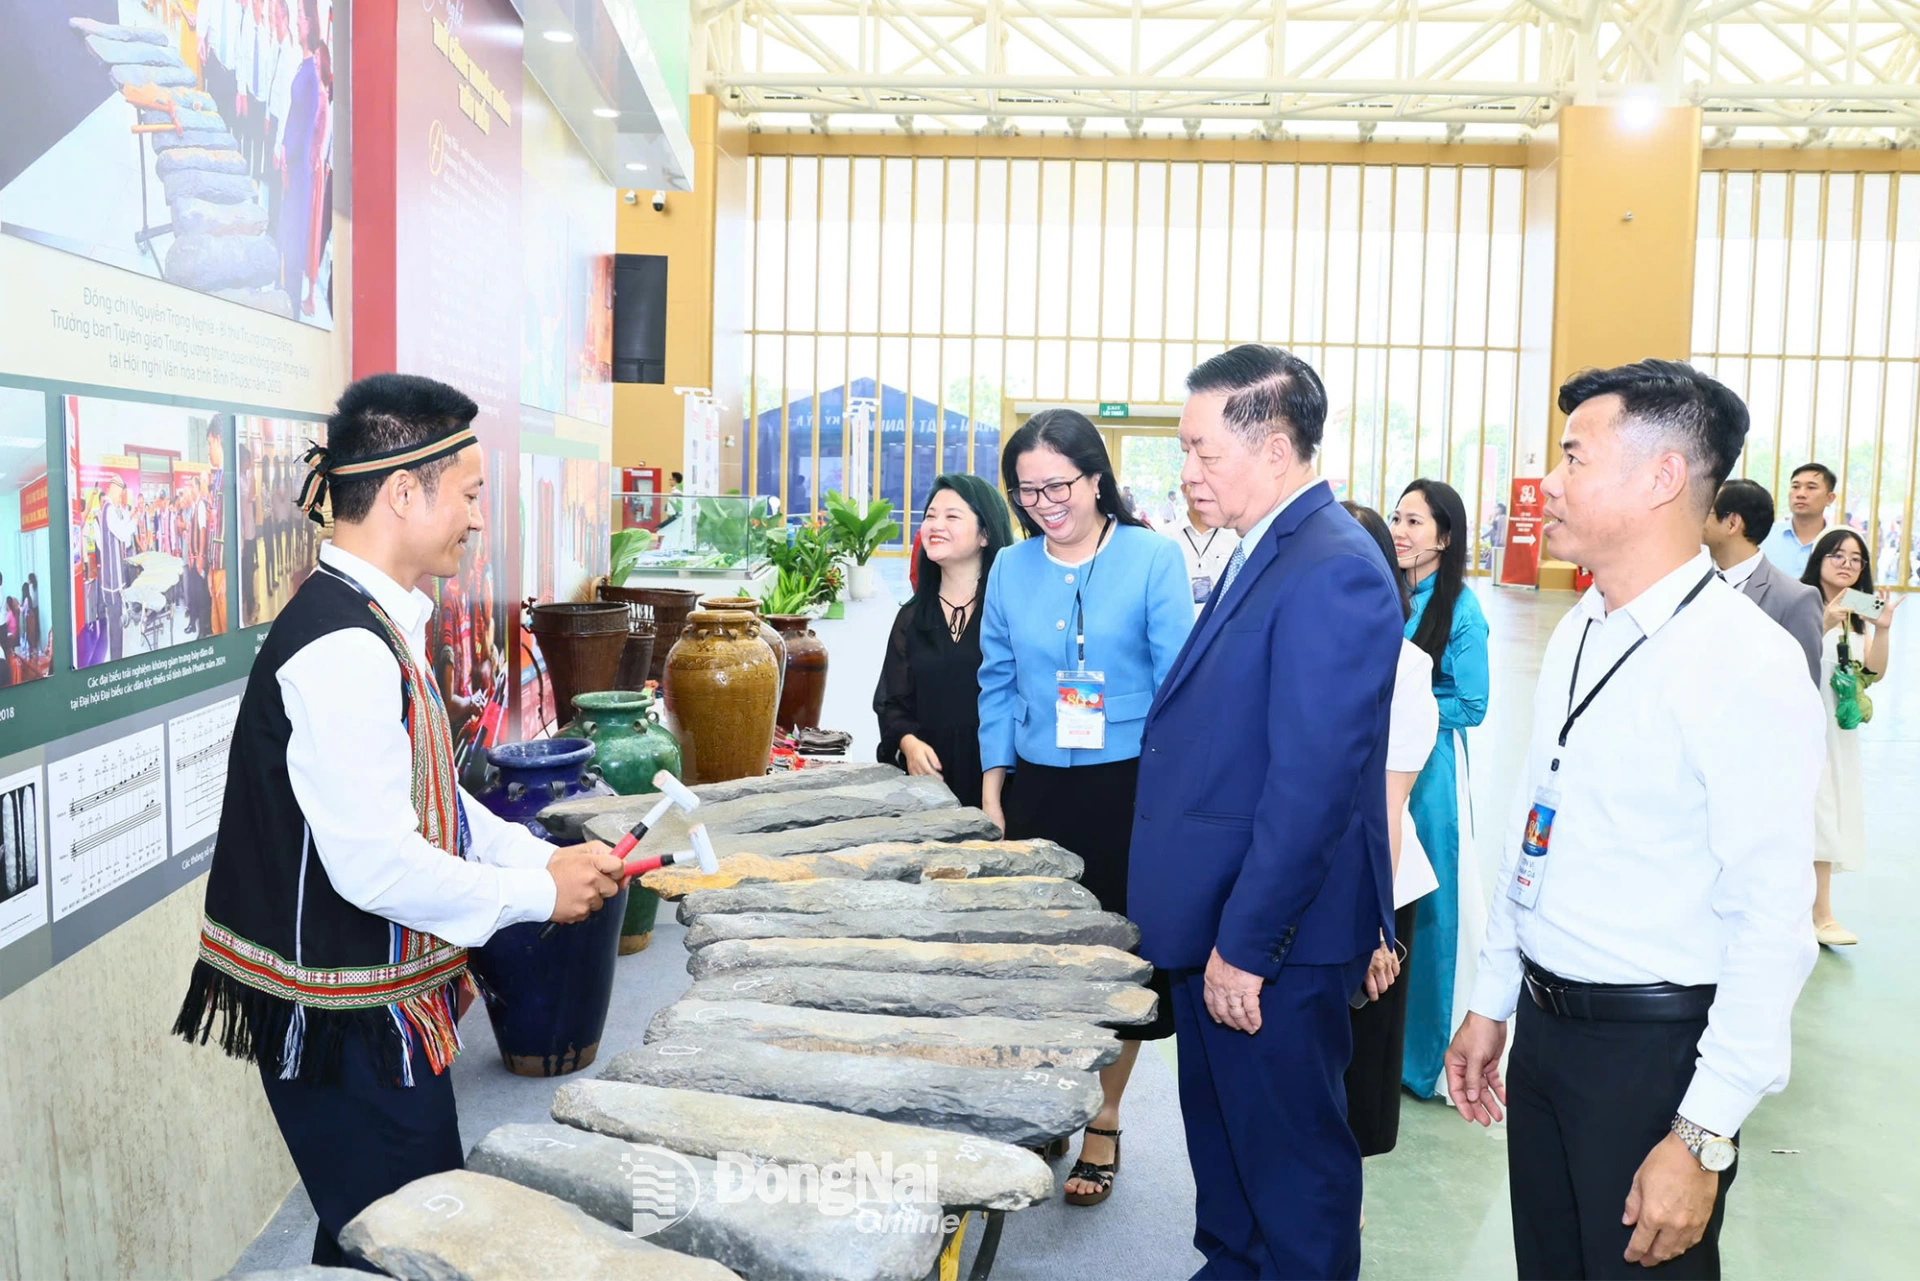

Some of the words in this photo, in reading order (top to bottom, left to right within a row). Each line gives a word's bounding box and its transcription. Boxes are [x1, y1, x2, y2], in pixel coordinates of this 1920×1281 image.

[84, 286, 112, 314] Đồng
[166, 308, 190, 332] Trọng
[50, 308, 90, 339] Trưởng
[93, 318, 112, 338] ban
[114, 322, 142, 346] Tuyên
[144, 331, 162, 350] giáo
[164, 334, 188, 358] Trung
[109, 352, 120, 372] tại
[124, 352, 140, 375] Hội
[70, 698, 78, 711] tại
[79, 694, 90, 706] Đại
[90, 690, 100, 705] hội
[100, 688, 110, 702] Đại
[110, 683, 123, 698] biểu
[124, 682, 133, 694] các
[134, 680, 144, 691] dân
[144, 678, 154, 690] tộc
[166, 670, 172, 682] số
[182, 664, 192, 676] Bình
[87, 676, 98, 688] Các
[99, 672, 109, 686] đại
[110, 668, 122, 683] biểu
[122, 668, 131, 680] trải
[132, 662, 152, 678] nghiệm
[152, 658, 168, 671] không
[168, 656, 178, 668] gian
